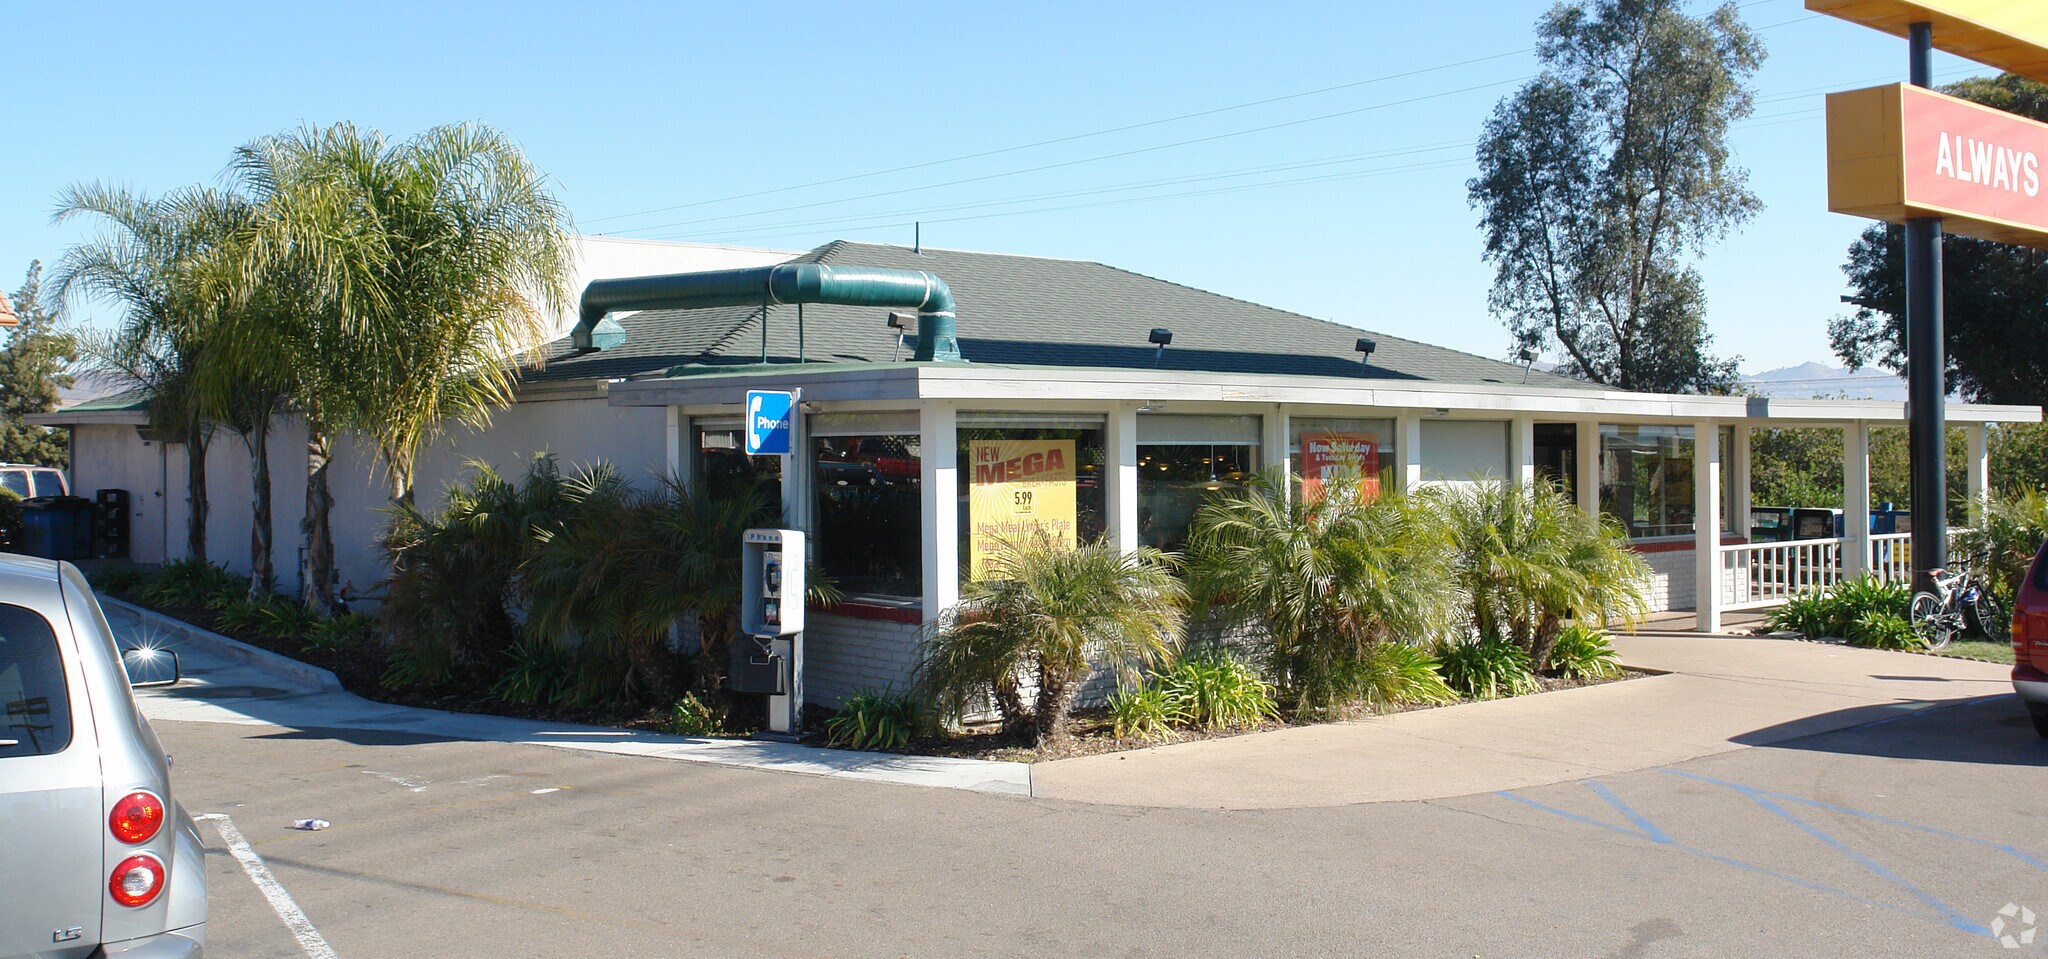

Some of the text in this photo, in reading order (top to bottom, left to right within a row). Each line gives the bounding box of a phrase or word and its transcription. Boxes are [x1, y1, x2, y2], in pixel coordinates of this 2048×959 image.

[1936, 131, 2039, 198] ALWAYS
[757, 416, 789, 430] Phone
[977, 447, 1000, 463] NEW
[1309, 441, 1329, 454] Now
[976, 448, 1065, 487] MEGA
[1022, 472, 1067, 488] BREAKFASTS
[1014, 491, 1033, 506] 5.99
[977, 521, 999, 535] Mega
[1051, 518, 1071, 531] Plate
[750, 533, 780, 541] Phone
